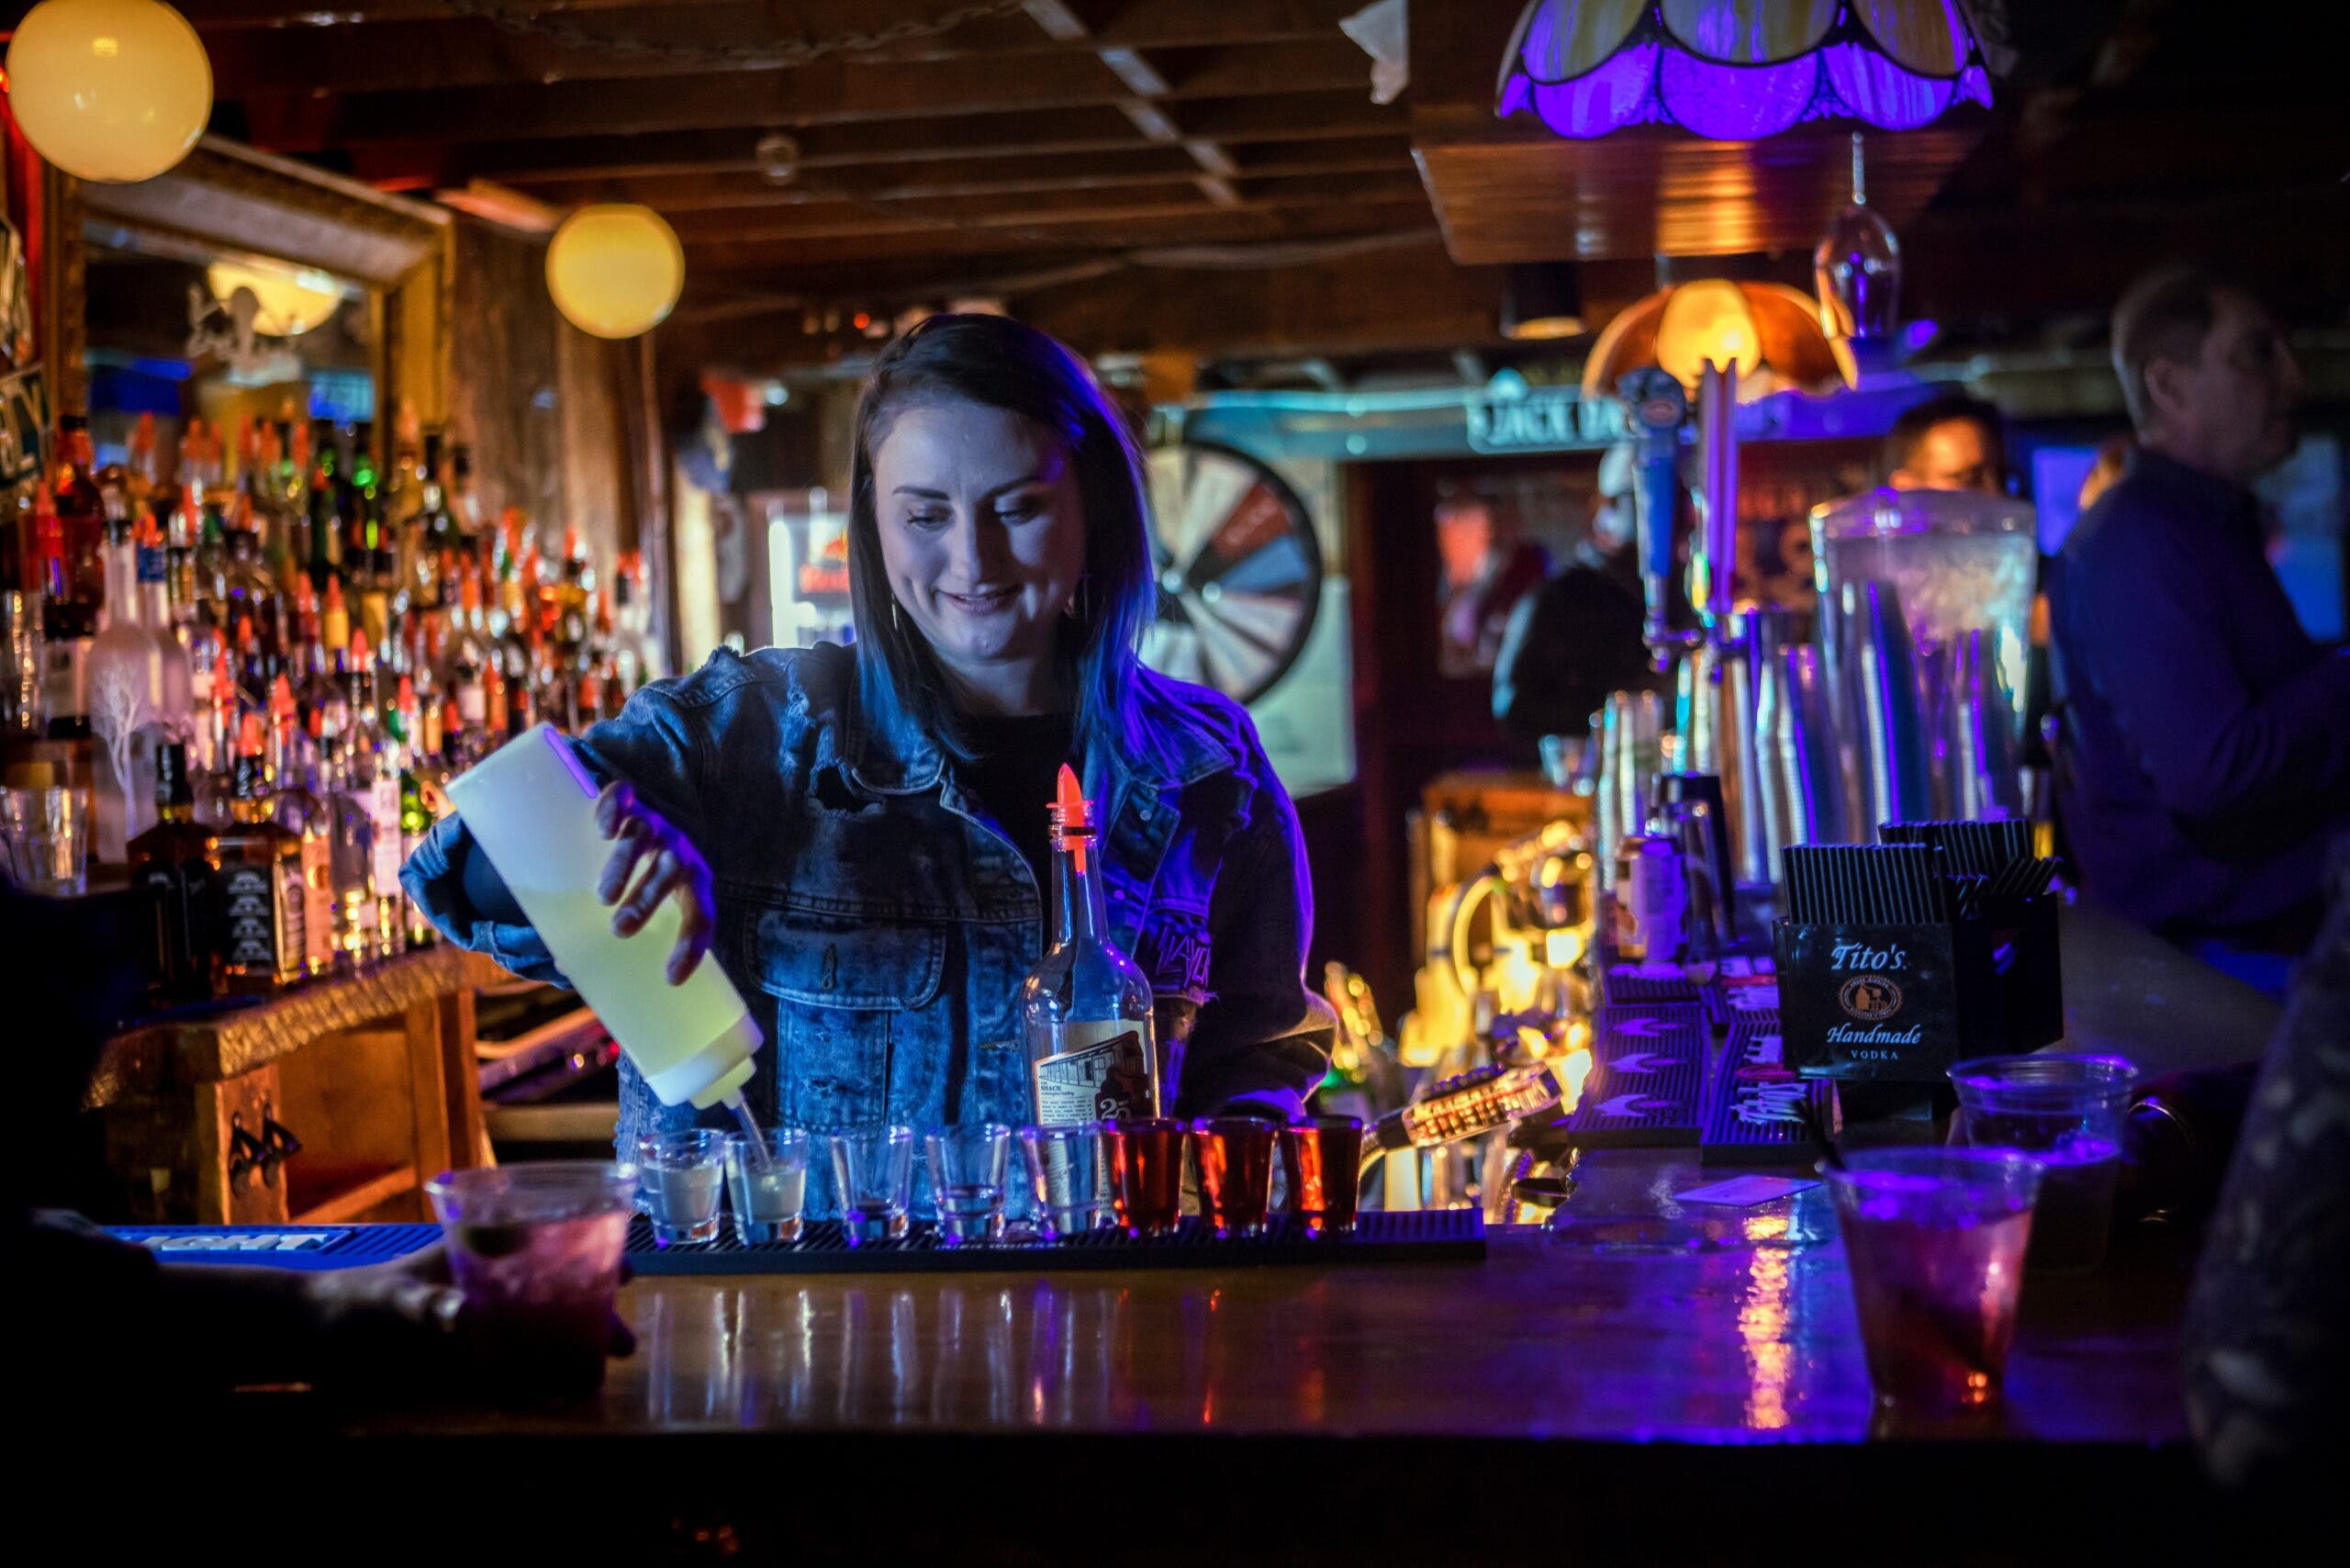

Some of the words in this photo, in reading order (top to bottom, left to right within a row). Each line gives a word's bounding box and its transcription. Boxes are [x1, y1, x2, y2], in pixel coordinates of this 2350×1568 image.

[1830, 942, 1908, 970] Tito's
[1827, 1022, 1922, 1045] Handmade
[1851, 1049, 1899, 1060] VODKA
[121, 1235, 329, 1251] IGHT
